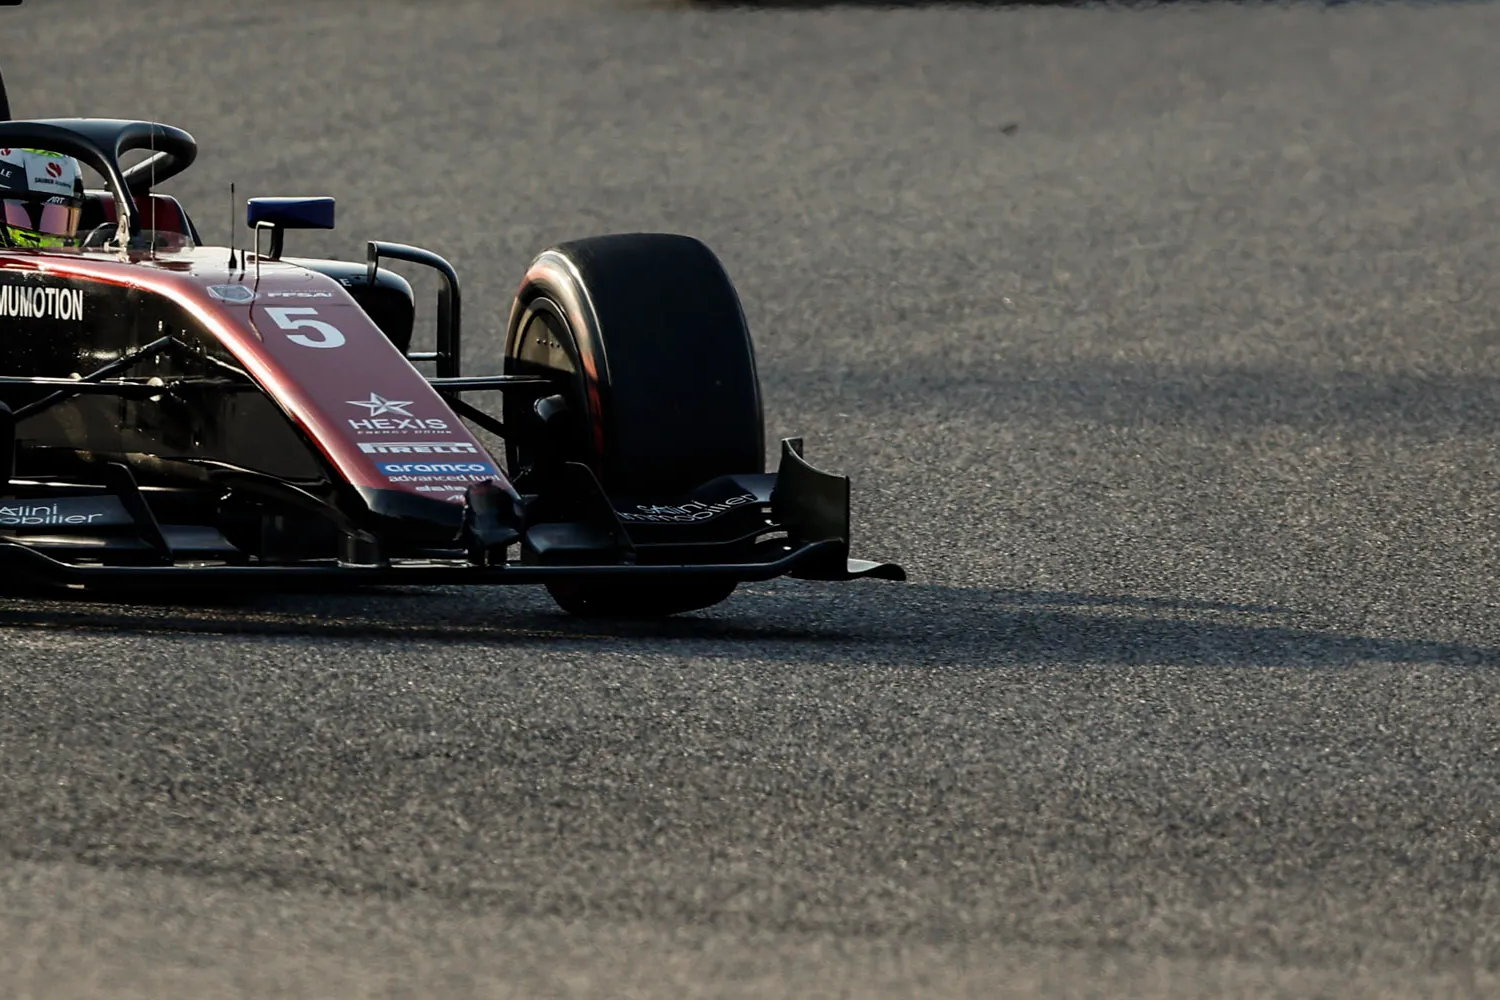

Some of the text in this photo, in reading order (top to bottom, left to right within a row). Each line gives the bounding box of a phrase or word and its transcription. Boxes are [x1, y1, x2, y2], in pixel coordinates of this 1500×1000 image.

[47, 196, 65, 204] ART
[264, 307, 346, 349] 5
[348, 419, 448, 430] HEXIS
[356, 442, 478, 454] PIRELLI
[385, 463, 486, 473] aramco
[388, 474, 468, 482] advanced
